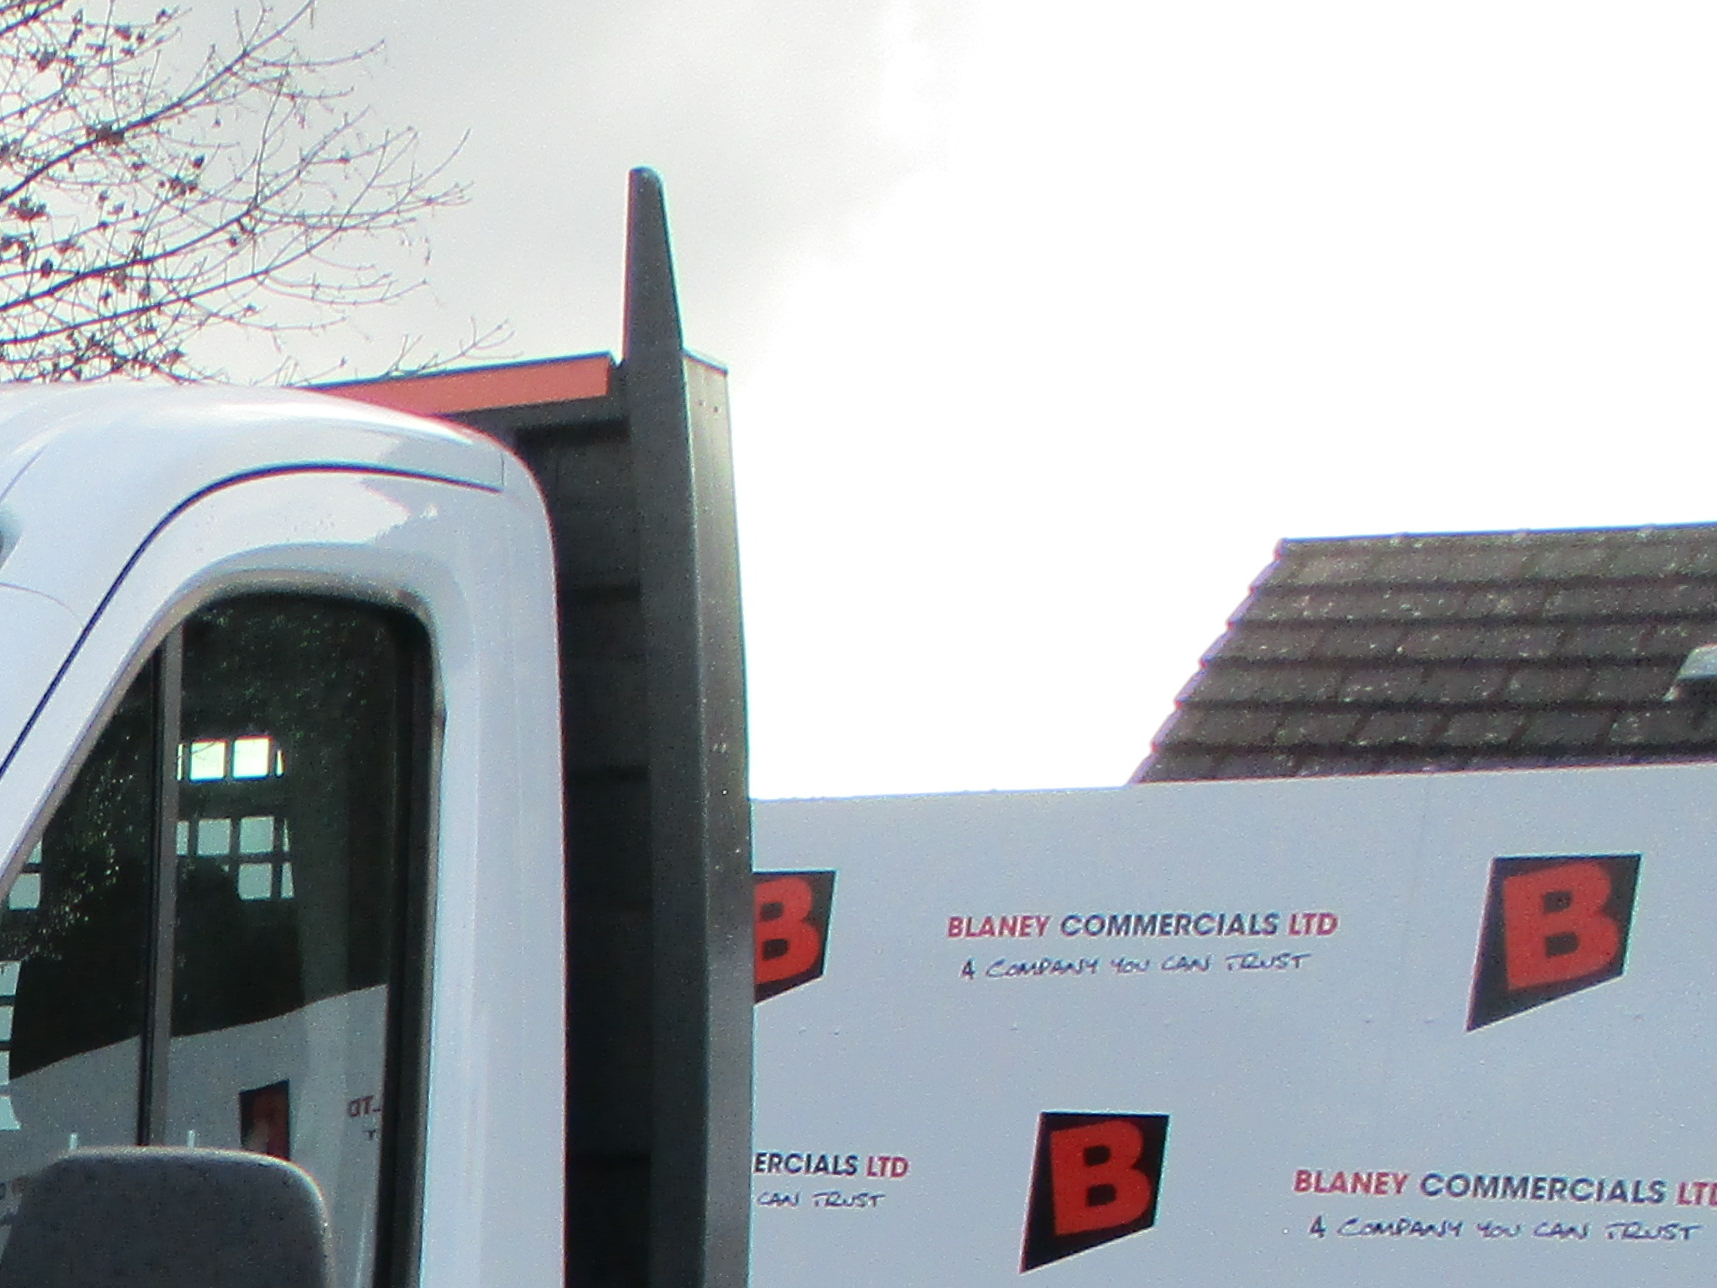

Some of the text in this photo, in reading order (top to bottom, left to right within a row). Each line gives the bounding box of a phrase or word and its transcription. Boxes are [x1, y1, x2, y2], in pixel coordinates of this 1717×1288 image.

[947, 912, 1338, 938] BLANEY COMMERCIALS LTD
[1502, 863, 1620, 990] B
[961, 952, 1312, 979] A COMPANY YOU CAN TRUST
[866, 1155, 909, 1178] LTD
[1049, 1119, 1152, 1235] B
[757, 1190, 886, 1208] CAN TRUST
[1293, 1169, 1410, 1195] BLANEY
[1419, 1172, 1668, 1204] COMMERCIALS
[1308, 1215, 1705, 1242] A COMPANY YOU CAN TRUST
